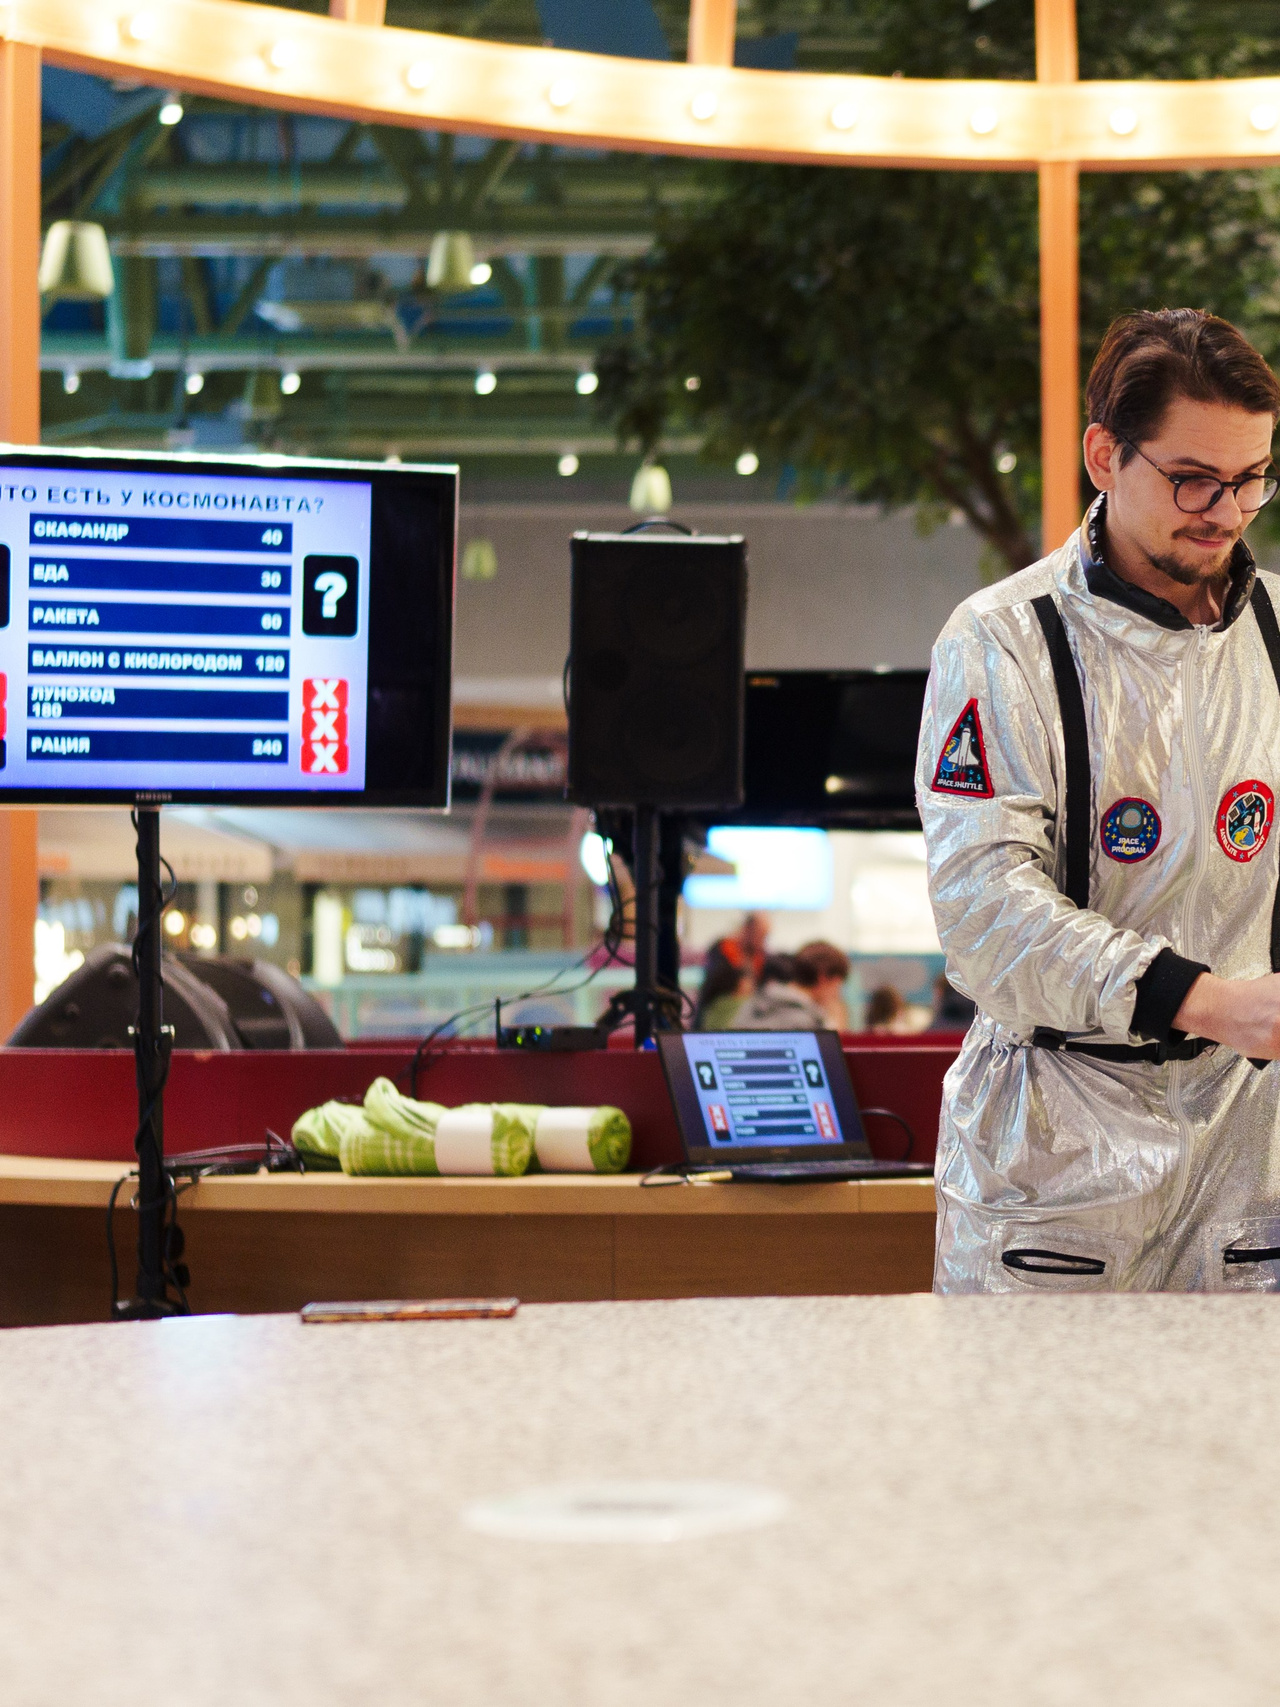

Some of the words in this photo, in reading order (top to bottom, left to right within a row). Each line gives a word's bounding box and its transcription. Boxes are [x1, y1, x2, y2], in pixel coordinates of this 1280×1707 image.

[47, 486, 110, 505] ЕСТЬ
[121, 489, 133, 507] У
[143, 489, 324, 514] КОСМОНАВТА?
[33, 520, 129, 541] СКАФАНДР
[261, 529, 283, 545] 40
[33, 564, 69, 583] ЕДА
[260, 570, 282, 588] 30
[32, 607, 99, 625] РАКЕТА
[261, 613, 282, 630] 60
[32, 650, 104, 668] БАЛЛОН
[108, 652, 120, 668] С
[124, 652, 242, 672] КИСЛОРОДОМ
[255, 655, 285, 672] 120
[31, 686, 115, 704] ЛУНОХОД
[32, 702, 62, 718] 180
[31, 736, 90, 755] РАЦИЯ
[252, 739, 282, 756] 240
[937, 779, 954, 787] SPACE
[954, 781, 983, 791] SHUTTLE
[1111, 846, 1147, 854] PROGRAM
[1118, 837, 1140, 845] SPACE
[1219, 828, 1238, 857] SATELLITE
